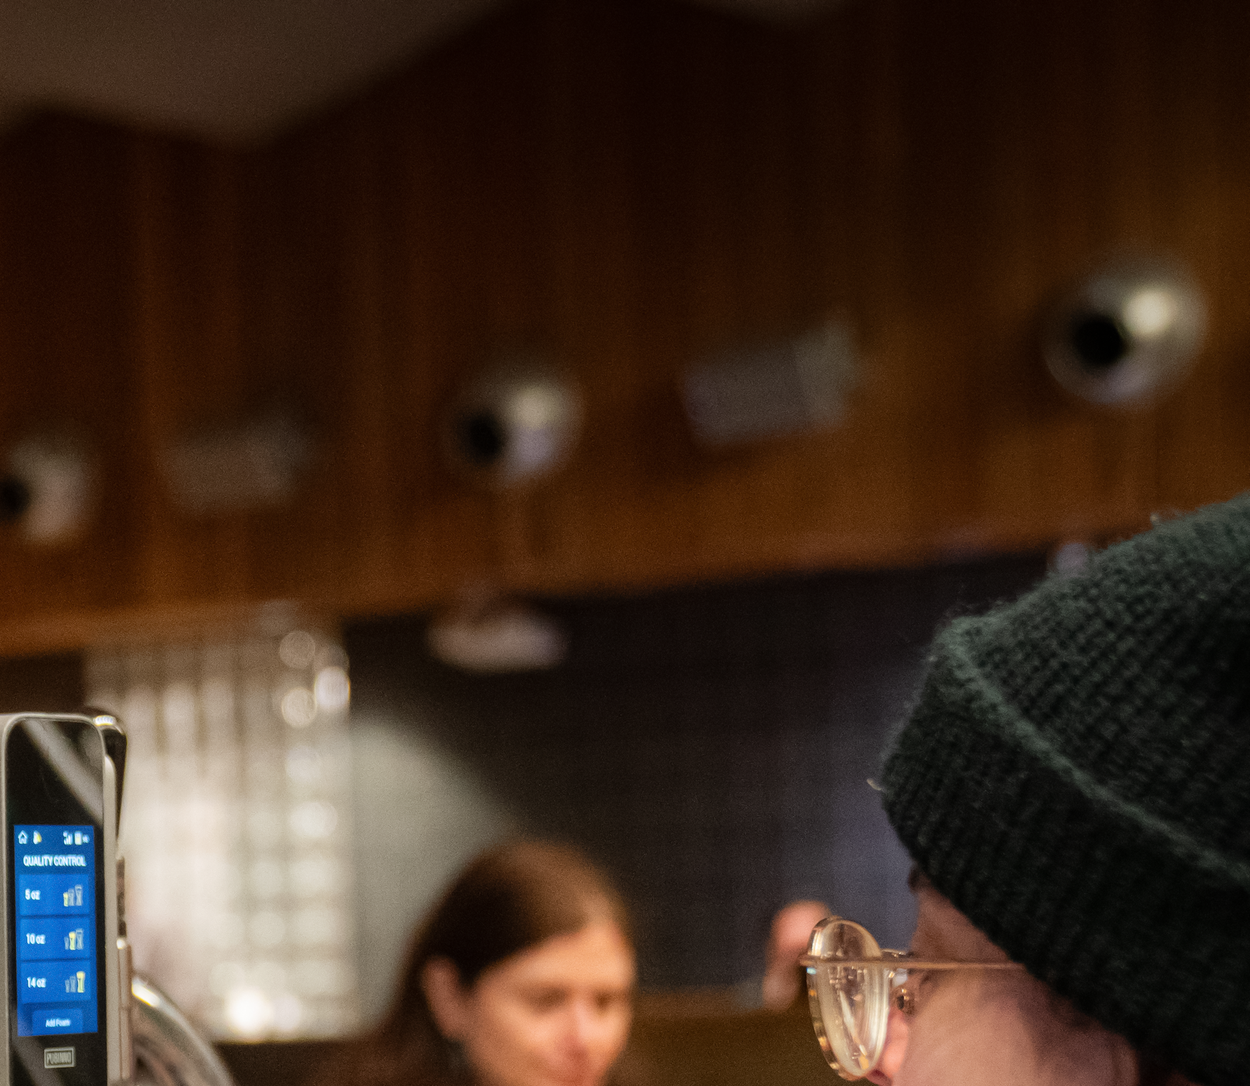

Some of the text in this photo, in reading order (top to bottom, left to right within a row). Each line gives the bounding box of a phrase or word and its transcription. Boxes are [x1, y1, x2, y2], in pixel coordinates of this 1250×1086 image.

[23, 854, 87, 867] QUALITY CONTROL
[31, 890, 41, 901] oz
[26, 933, 46, 945] 10 oz
[27, 977, 47, 988] 14 oz
